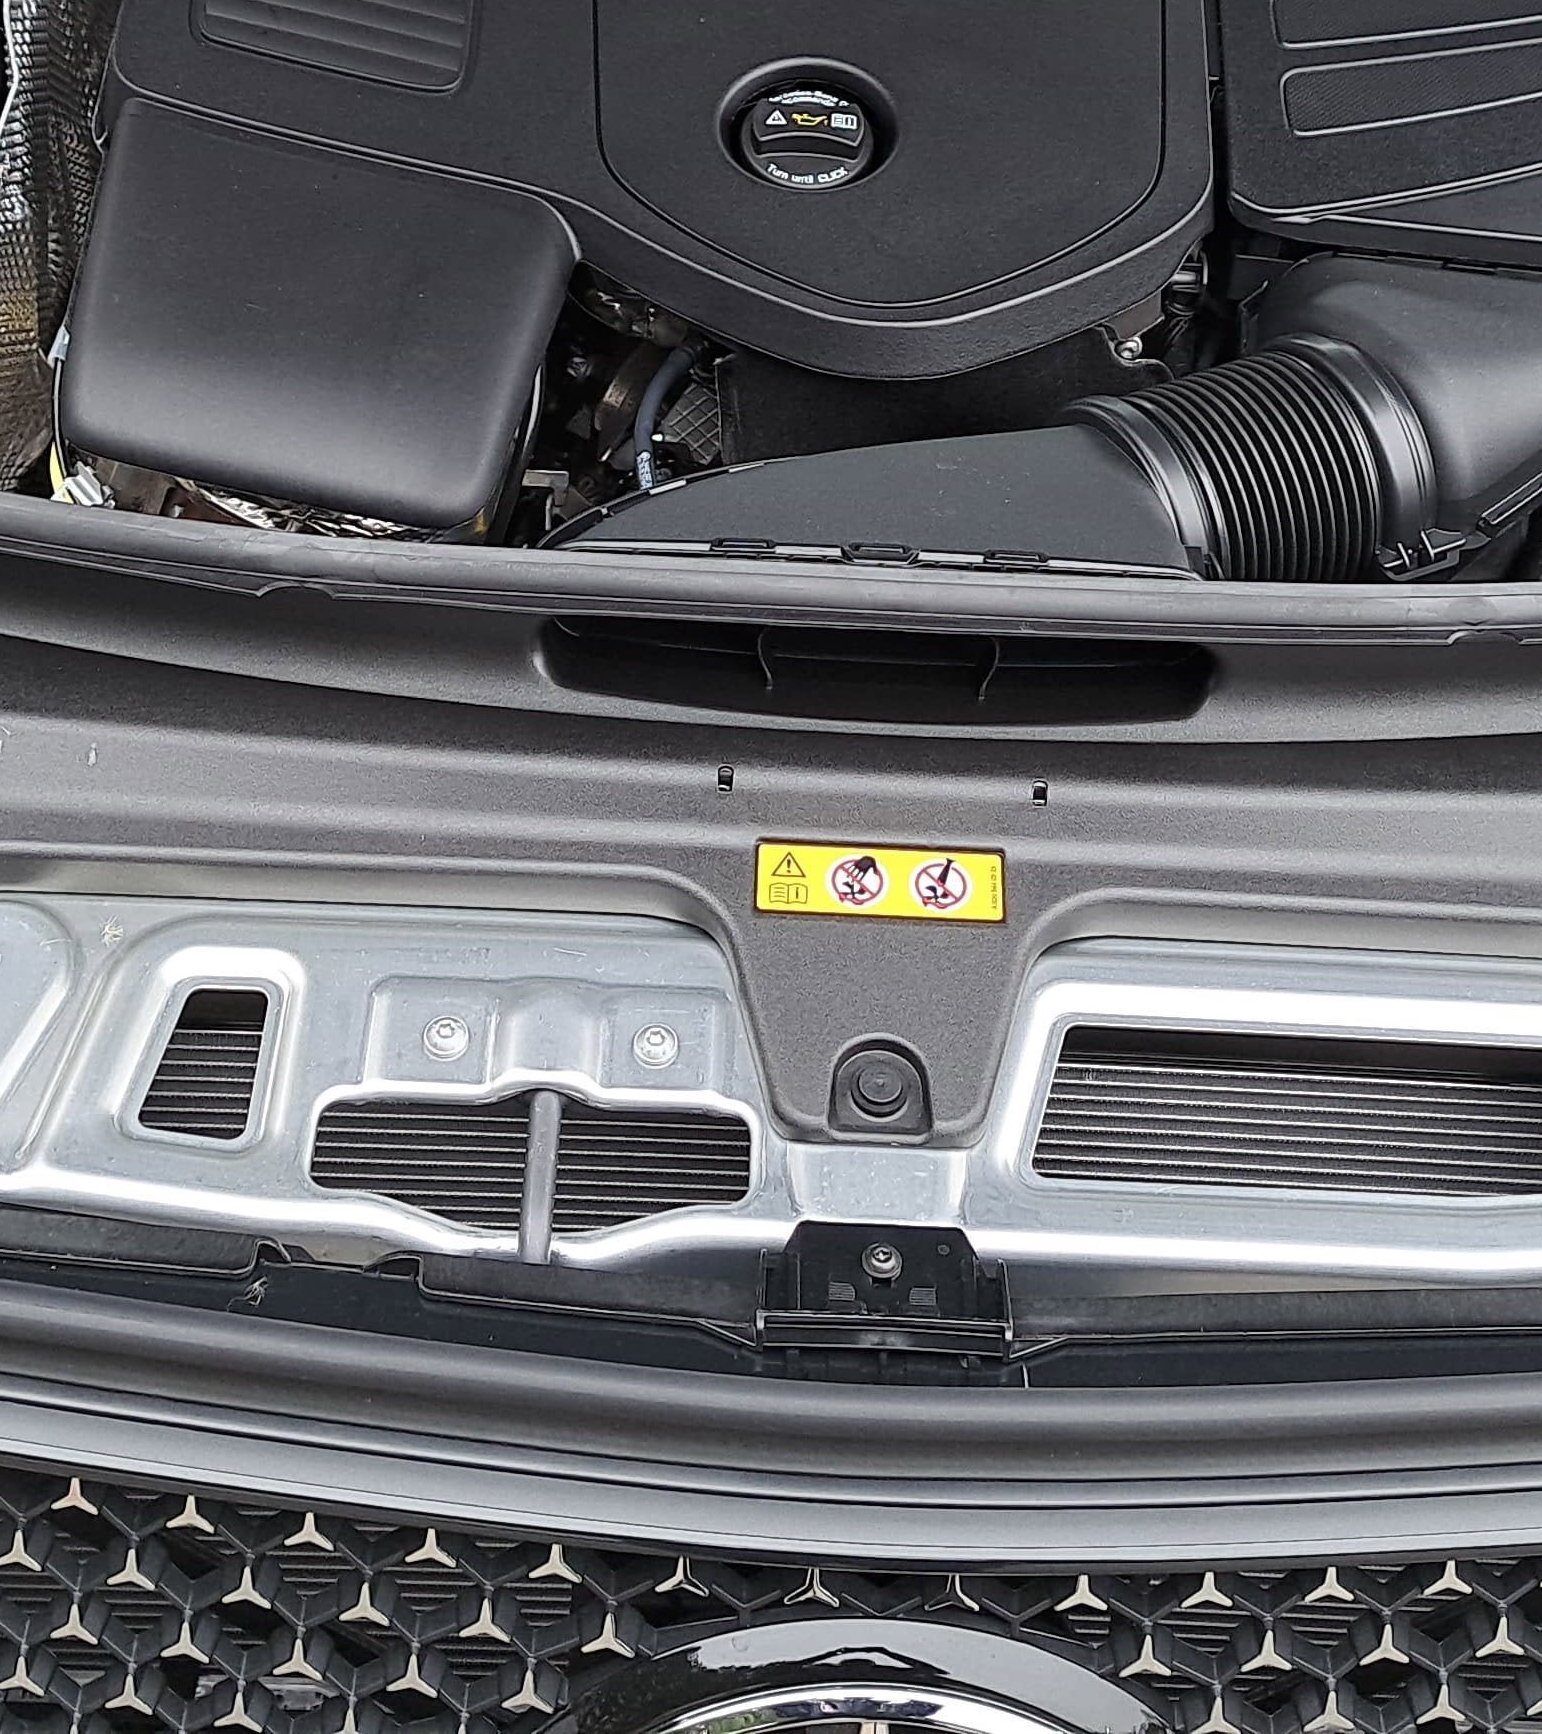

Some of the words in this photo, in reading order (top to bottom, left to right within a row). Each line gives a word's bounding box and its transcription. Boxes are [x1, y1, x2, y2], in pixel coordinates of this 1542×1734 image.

[767, 162, 789, 180] Turn
[791, 174, 814, 184] until
[817, 166, 849, 183] CLICK
